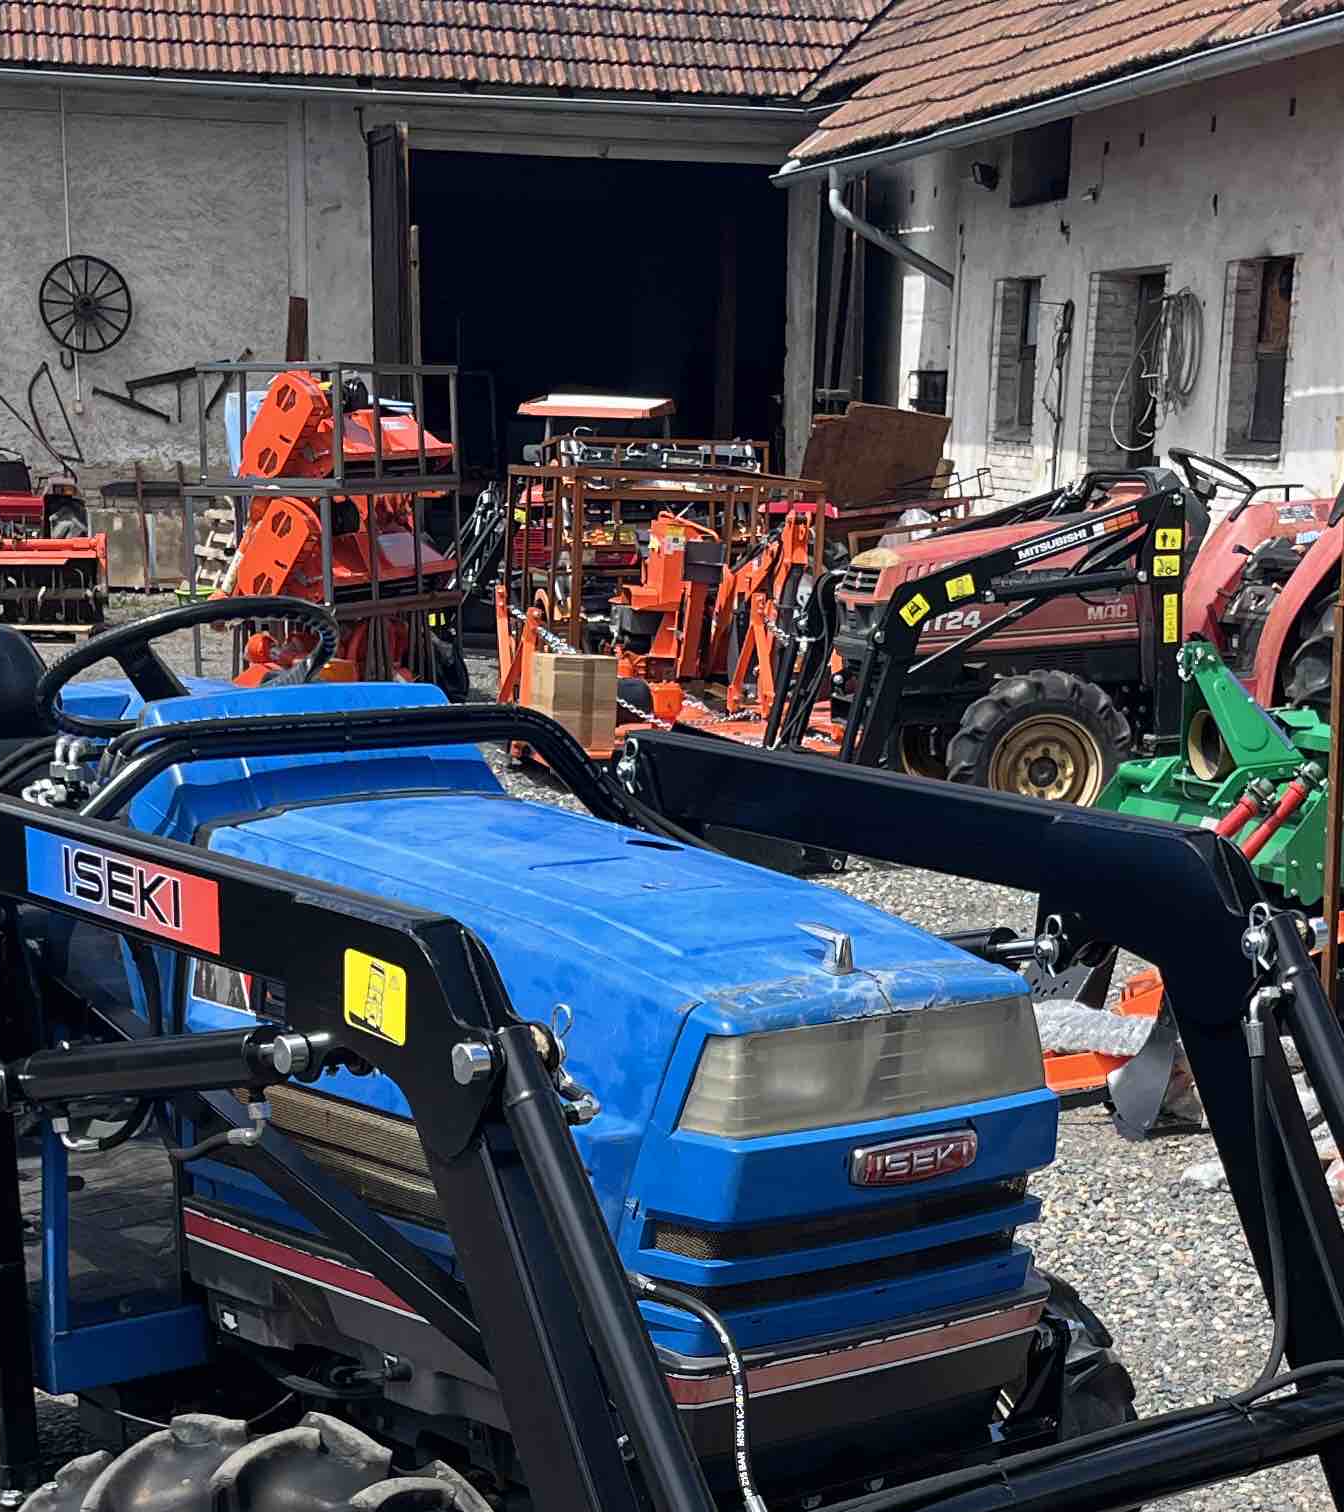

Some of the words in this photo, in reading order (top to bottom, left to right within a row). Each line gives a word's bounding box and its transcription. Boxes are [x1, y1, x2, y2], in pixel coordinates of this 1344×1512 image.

[1017, 527, 1088, 561] MITSUBISHI
[61, 844, 183, 931] ISEKI
[876, 1140, 970, 1178] ISEKI
